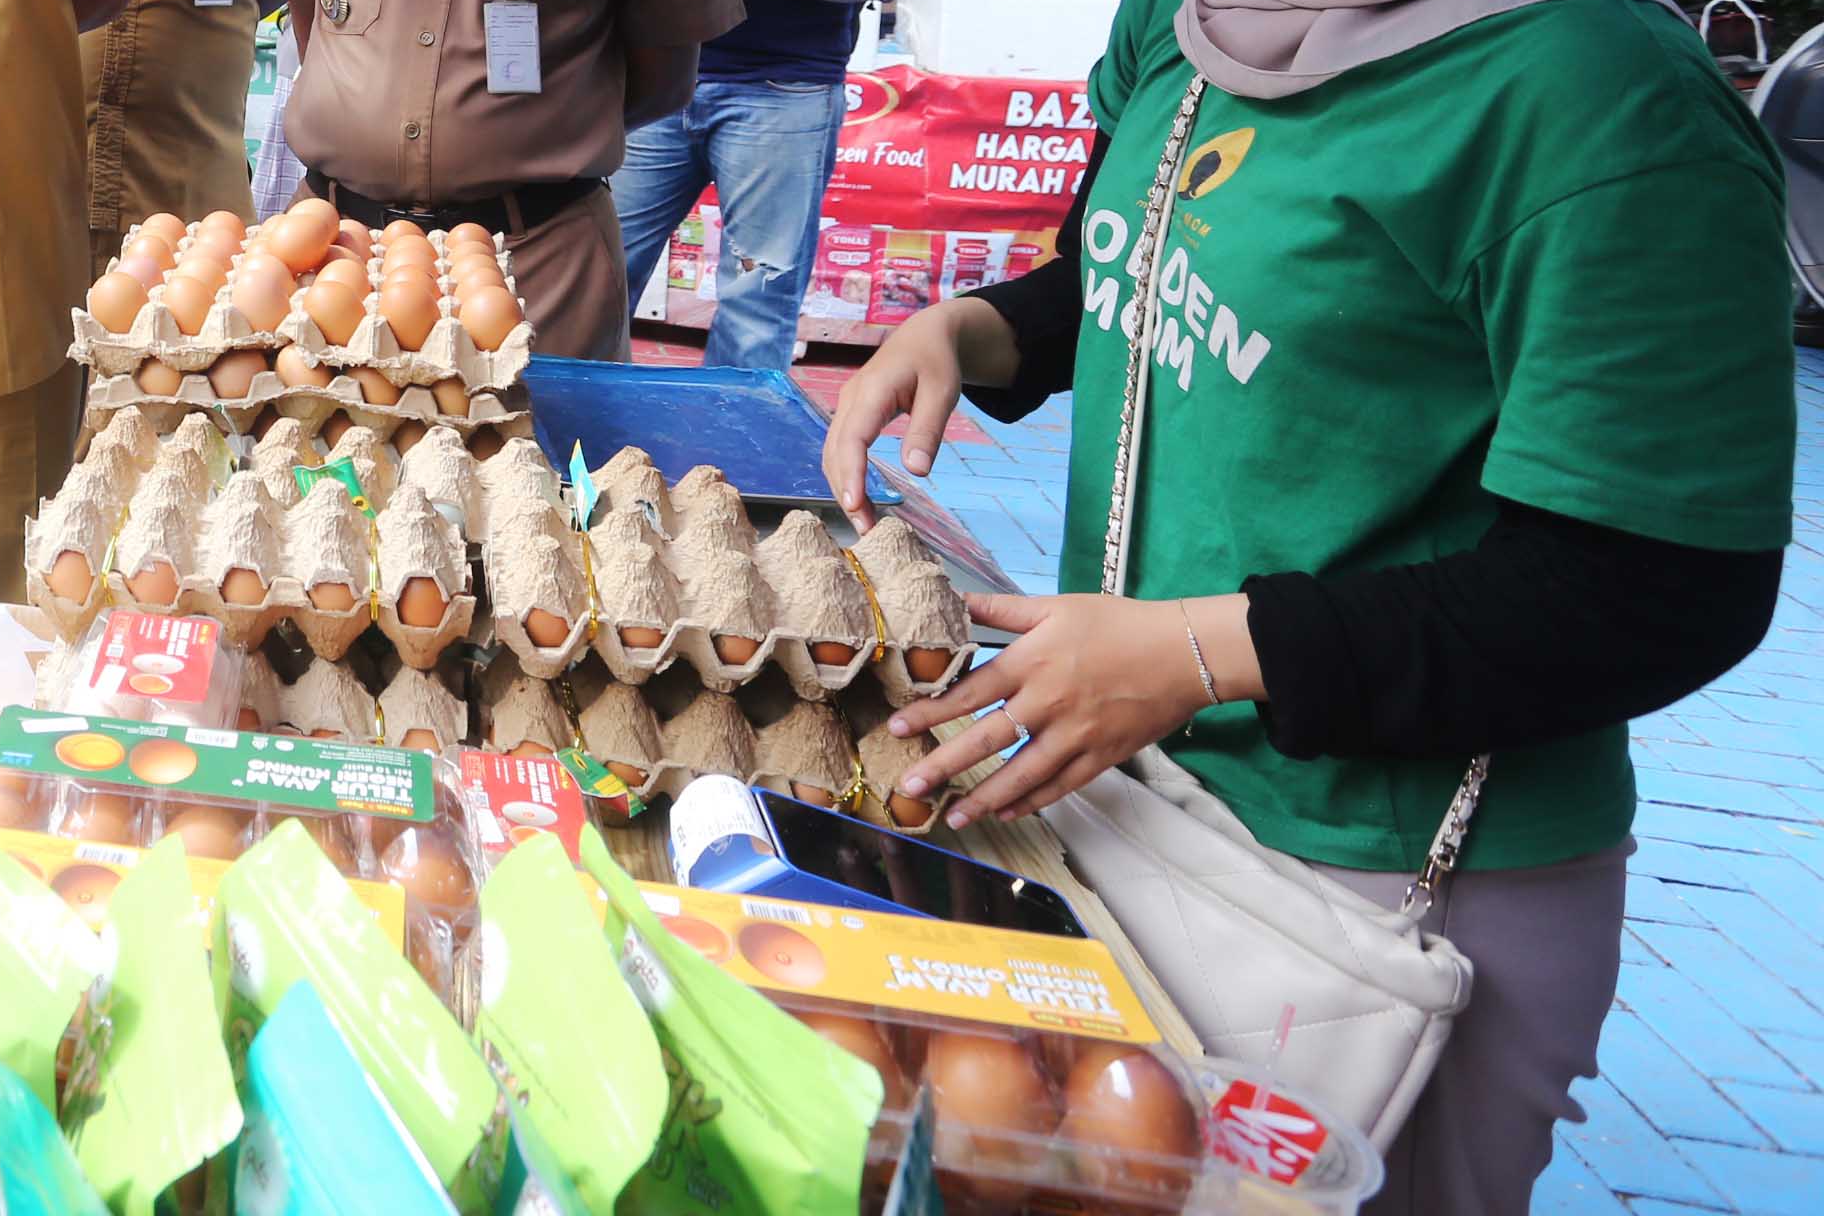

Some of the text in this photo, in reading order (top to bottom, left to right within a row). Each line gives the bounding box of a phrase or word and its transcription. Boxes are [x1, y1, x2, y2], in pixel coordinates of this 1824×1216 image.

[1005, 90, 1097, 129] BAZ
[835, 142, 925, 168] zen Food
[976, 133, 1088, 163] HARGA
[949, 163, 1066, 195] MURAH
[246, 769, 321, 792] AYAM
[247, 759, 413, 790] NEGERI KUNING
[331, 780, 413, 802] TELUR
[912, 957, 1007, 984] OMEGA
[1013, 971, 1107, 995] NEGERI
[893, 969, 1116, 1013] TELUR AYAM
